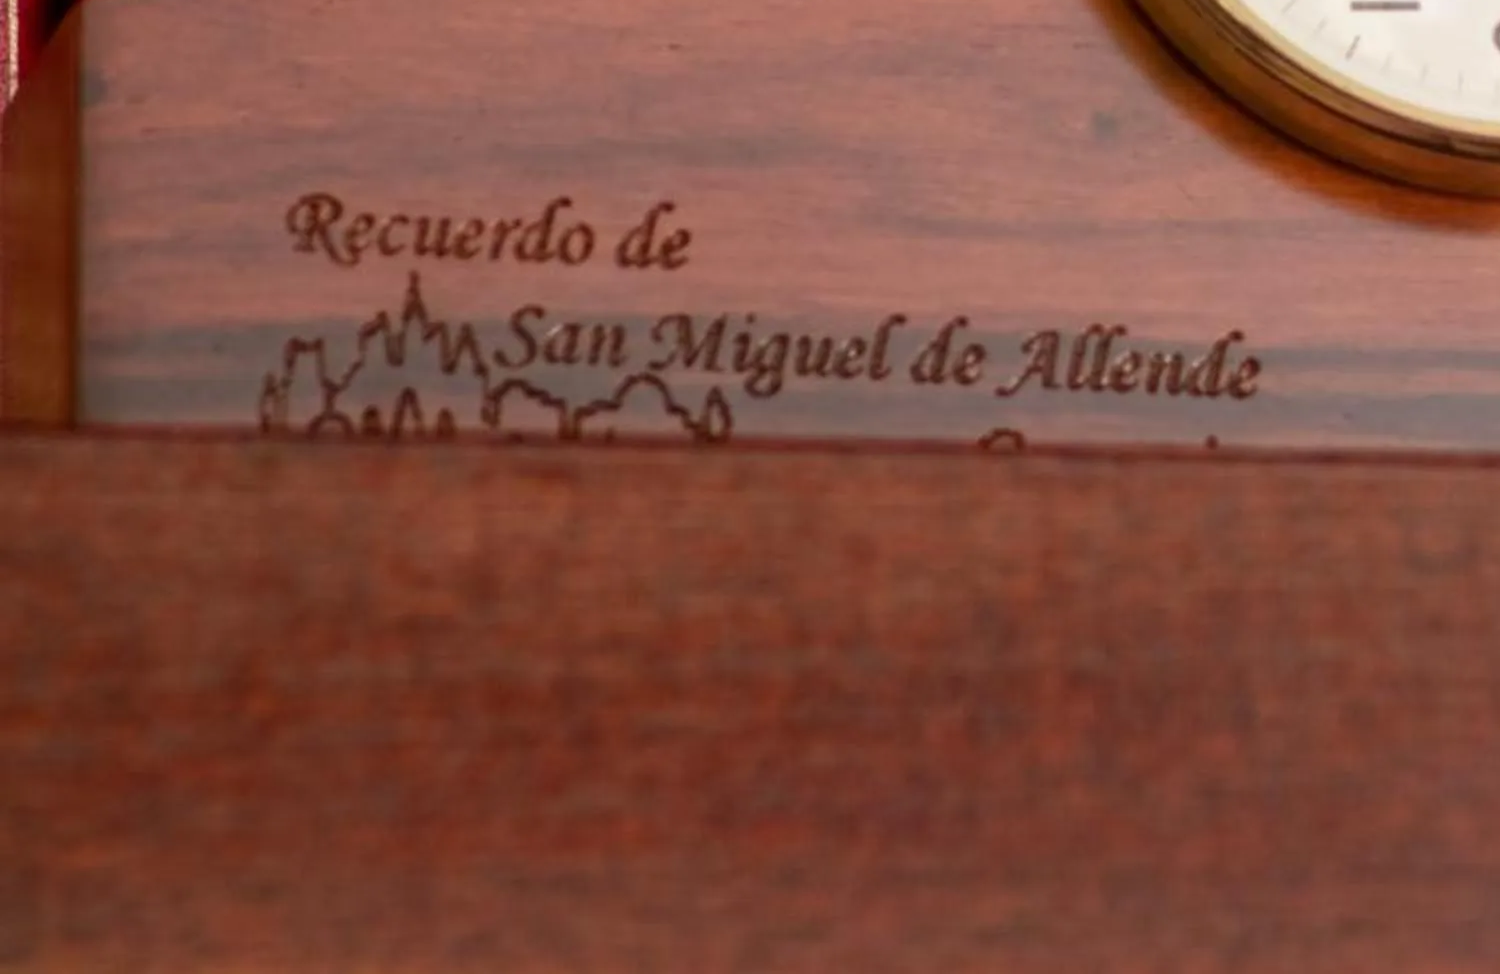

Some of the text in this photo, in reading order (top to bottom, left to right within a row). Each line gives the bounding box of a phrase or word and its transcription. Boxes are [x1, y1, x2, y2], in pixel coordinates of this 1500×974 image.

[284, 192, 692, 270] Recuerdo de
[493, 304, 1262, 400] San Miguel de Allende
